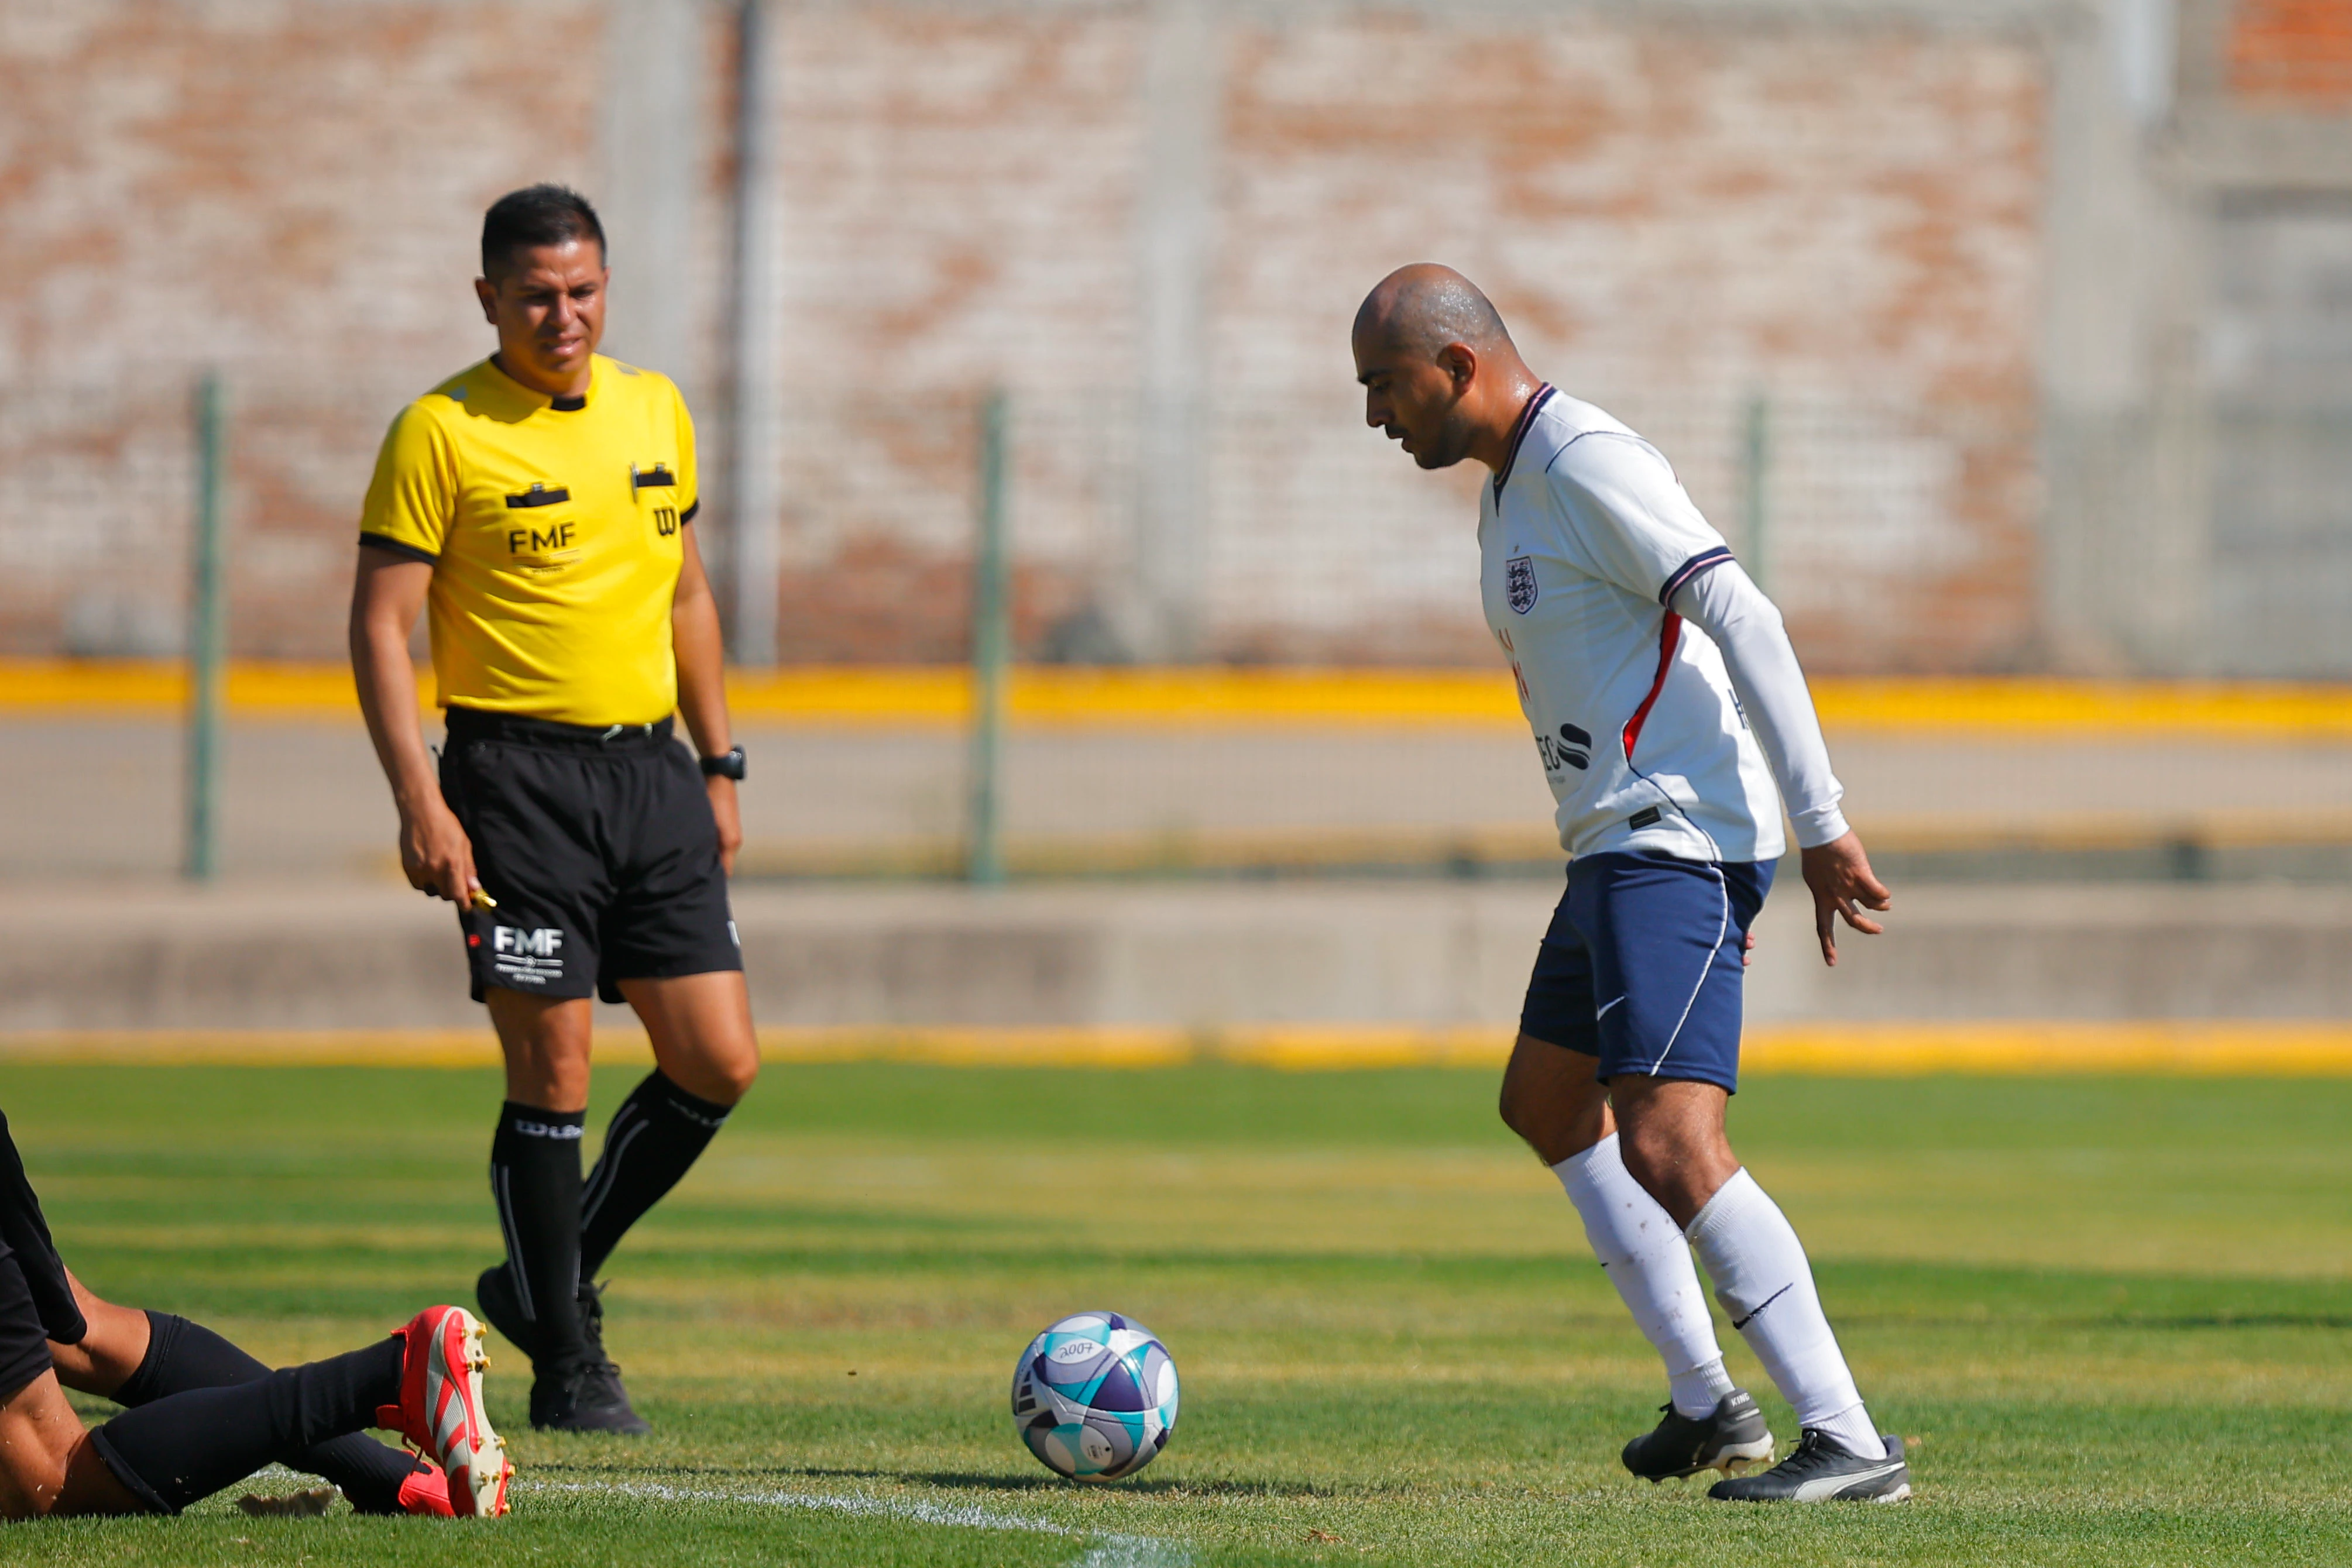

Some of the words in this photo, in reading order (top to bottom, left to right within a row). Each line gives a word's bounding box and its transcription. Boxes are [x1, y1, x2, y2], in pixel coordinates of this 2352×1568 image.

[509, 521, 576, 554] FMF
[494, 925, 564, 957] FMF
[1059, 1342, 1094, 1359] 2007
[1731, 1392, 1750, 1408] KING
